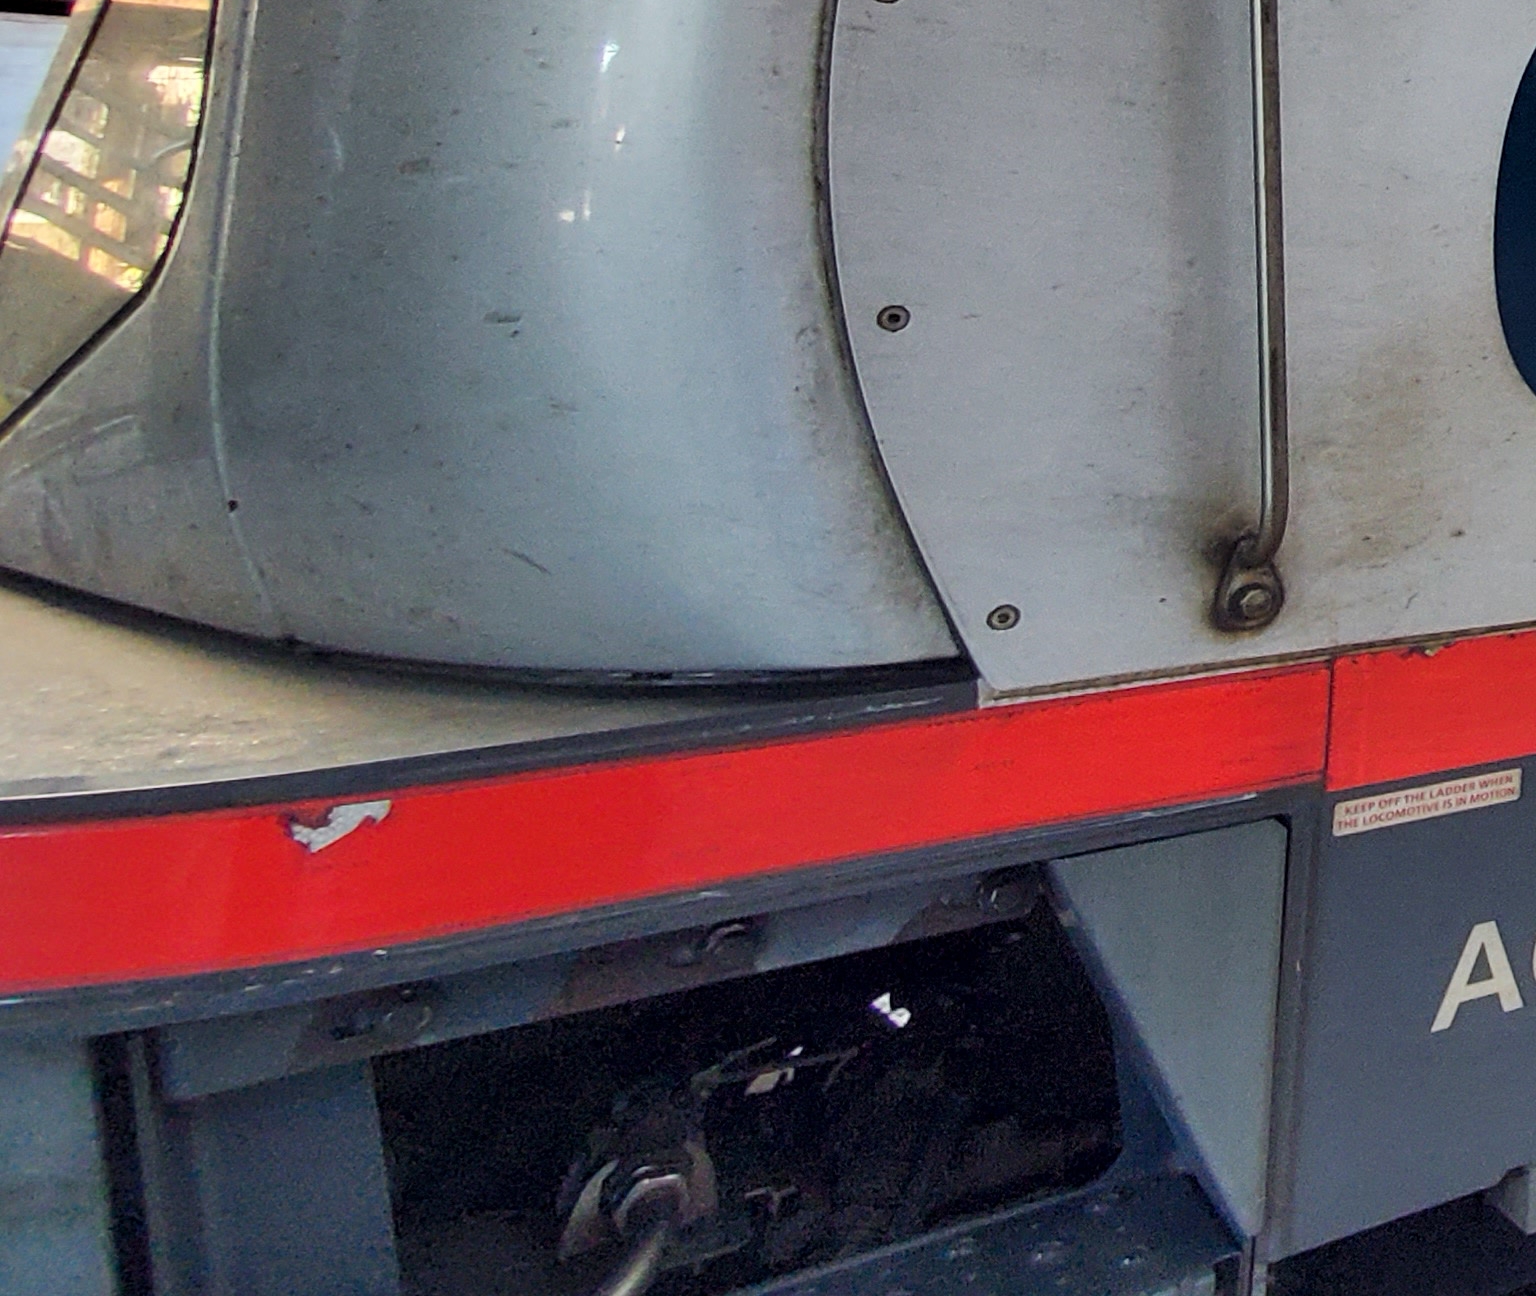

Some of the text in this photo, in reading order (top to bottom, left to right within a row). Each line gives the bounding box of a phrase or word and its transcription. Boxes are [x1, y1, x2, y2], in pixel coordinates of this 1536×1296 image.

[1337, 786, 1516, 831] THE LOCOMOTIVE IS IN MOTION
[1344, 775, 1514, 816] KEEP OFF THE LADDER WHEN
